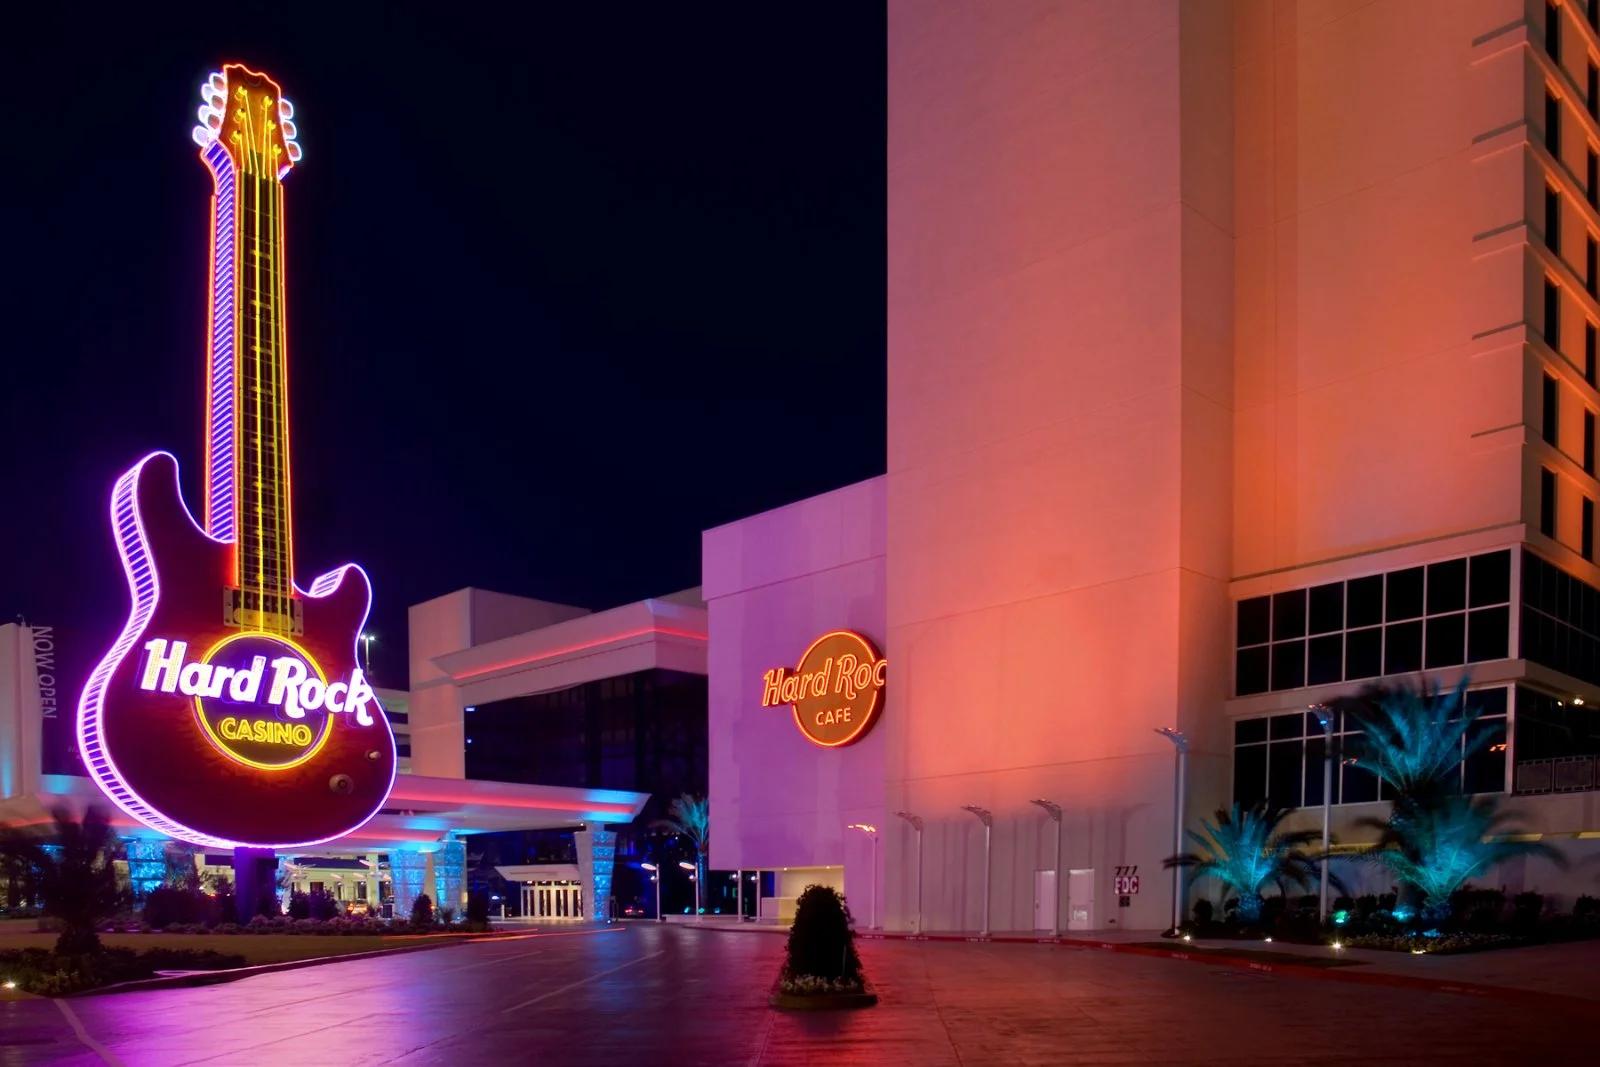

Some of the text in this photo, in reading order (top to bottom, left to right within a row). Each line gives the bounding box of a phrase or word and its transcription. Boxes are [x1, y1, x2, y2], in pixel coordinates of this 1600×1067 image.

[31, 626, 57, 718] NOW OPEN
[140, 638, 374, 726] Hard Rock
[761, 653, 887, 706] Hard Roc
[815, 707, 852, 726] CAFE
[220, 717, 312, 746] CASINO
[1114, 865, 1138, 877] 777
[1114, 877, 1138, 894] FDC
